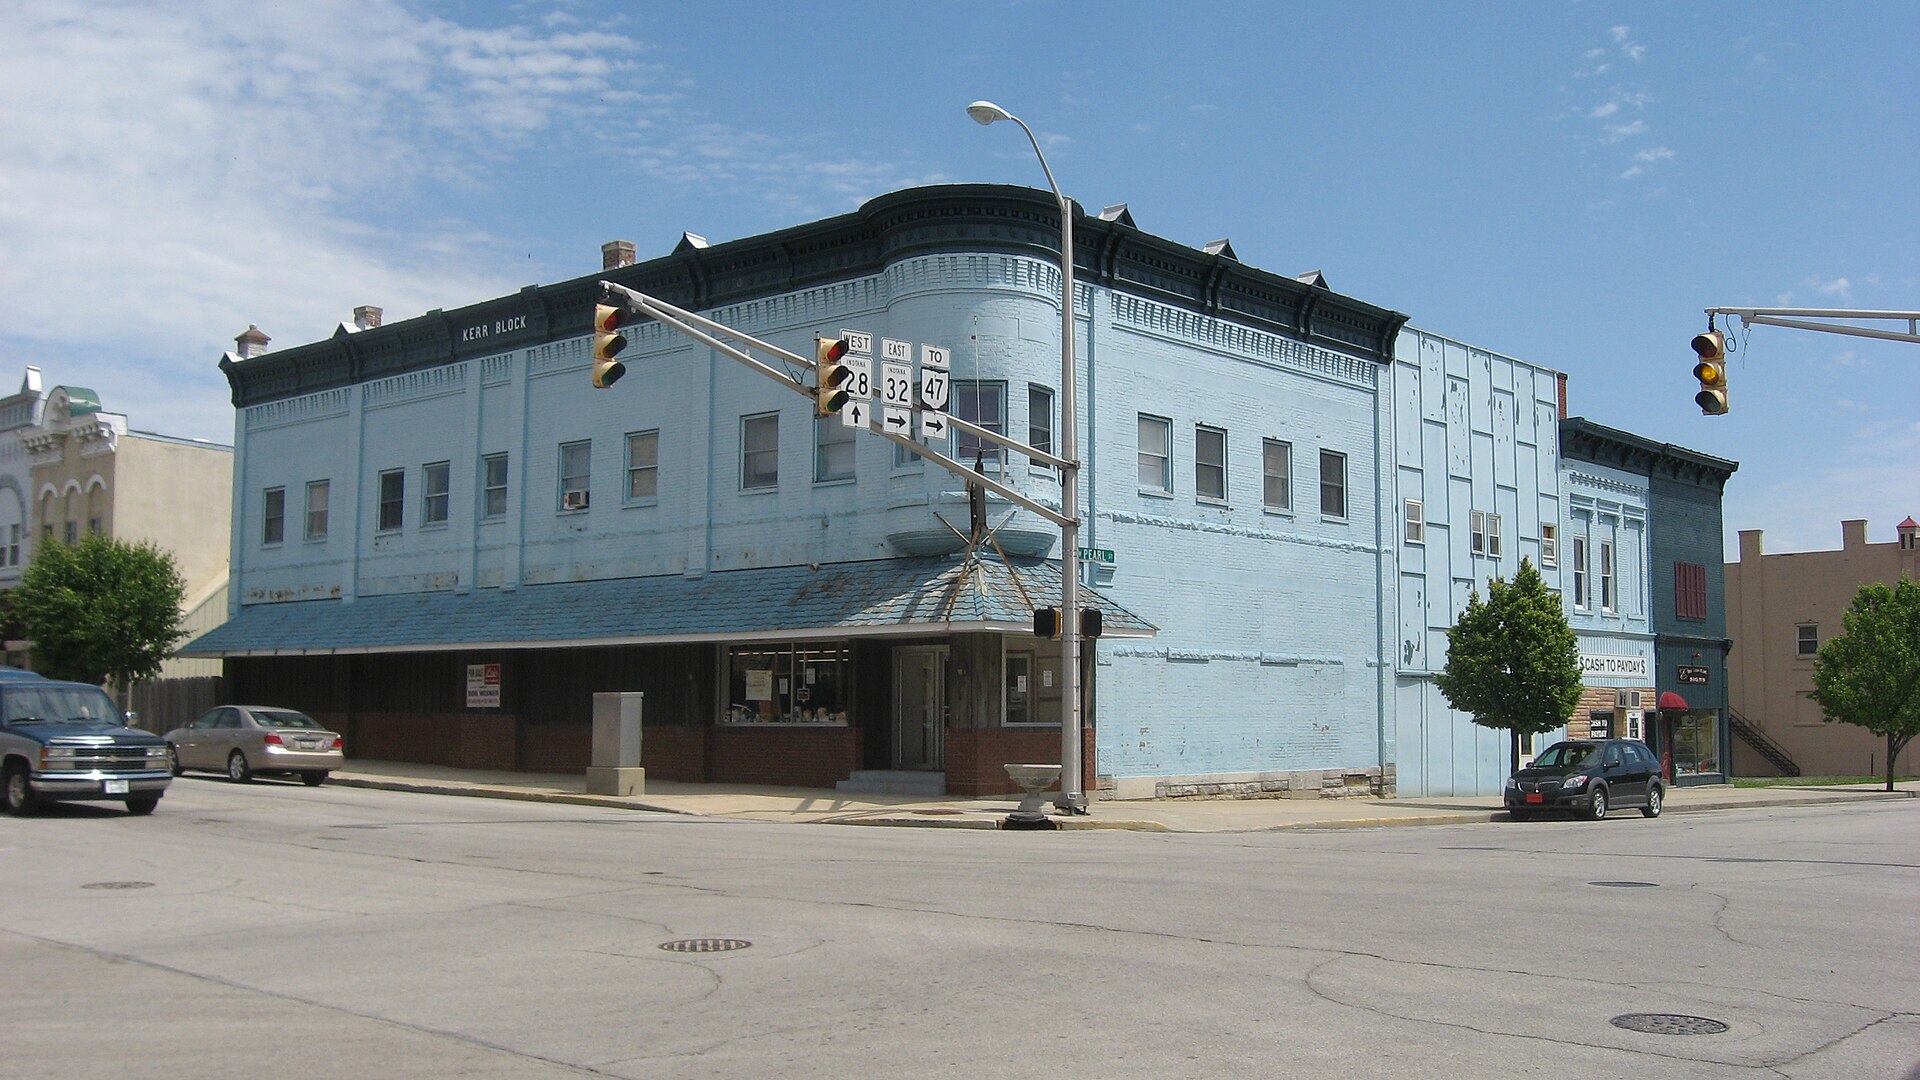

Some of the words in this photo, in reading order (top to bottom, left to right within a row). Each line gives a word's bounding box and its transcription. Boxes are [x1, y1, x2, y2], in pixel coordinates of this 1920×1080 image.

[463, 325, 489, 341] KERR
[495, 315, 527, 334] BLOCK
[888, 344, 905, 357] EAST
[929, 350, 942, 363] TO
[846, 371, 868, 395] 28
[925, 378, 943, 400] 47
[887, 378, 908, 402] 32
[1083, 549, 1106, 561] PEARL
[1606, 659, 1616, 672] TO
[1590, 730, 1608, 738] PAYDAY
